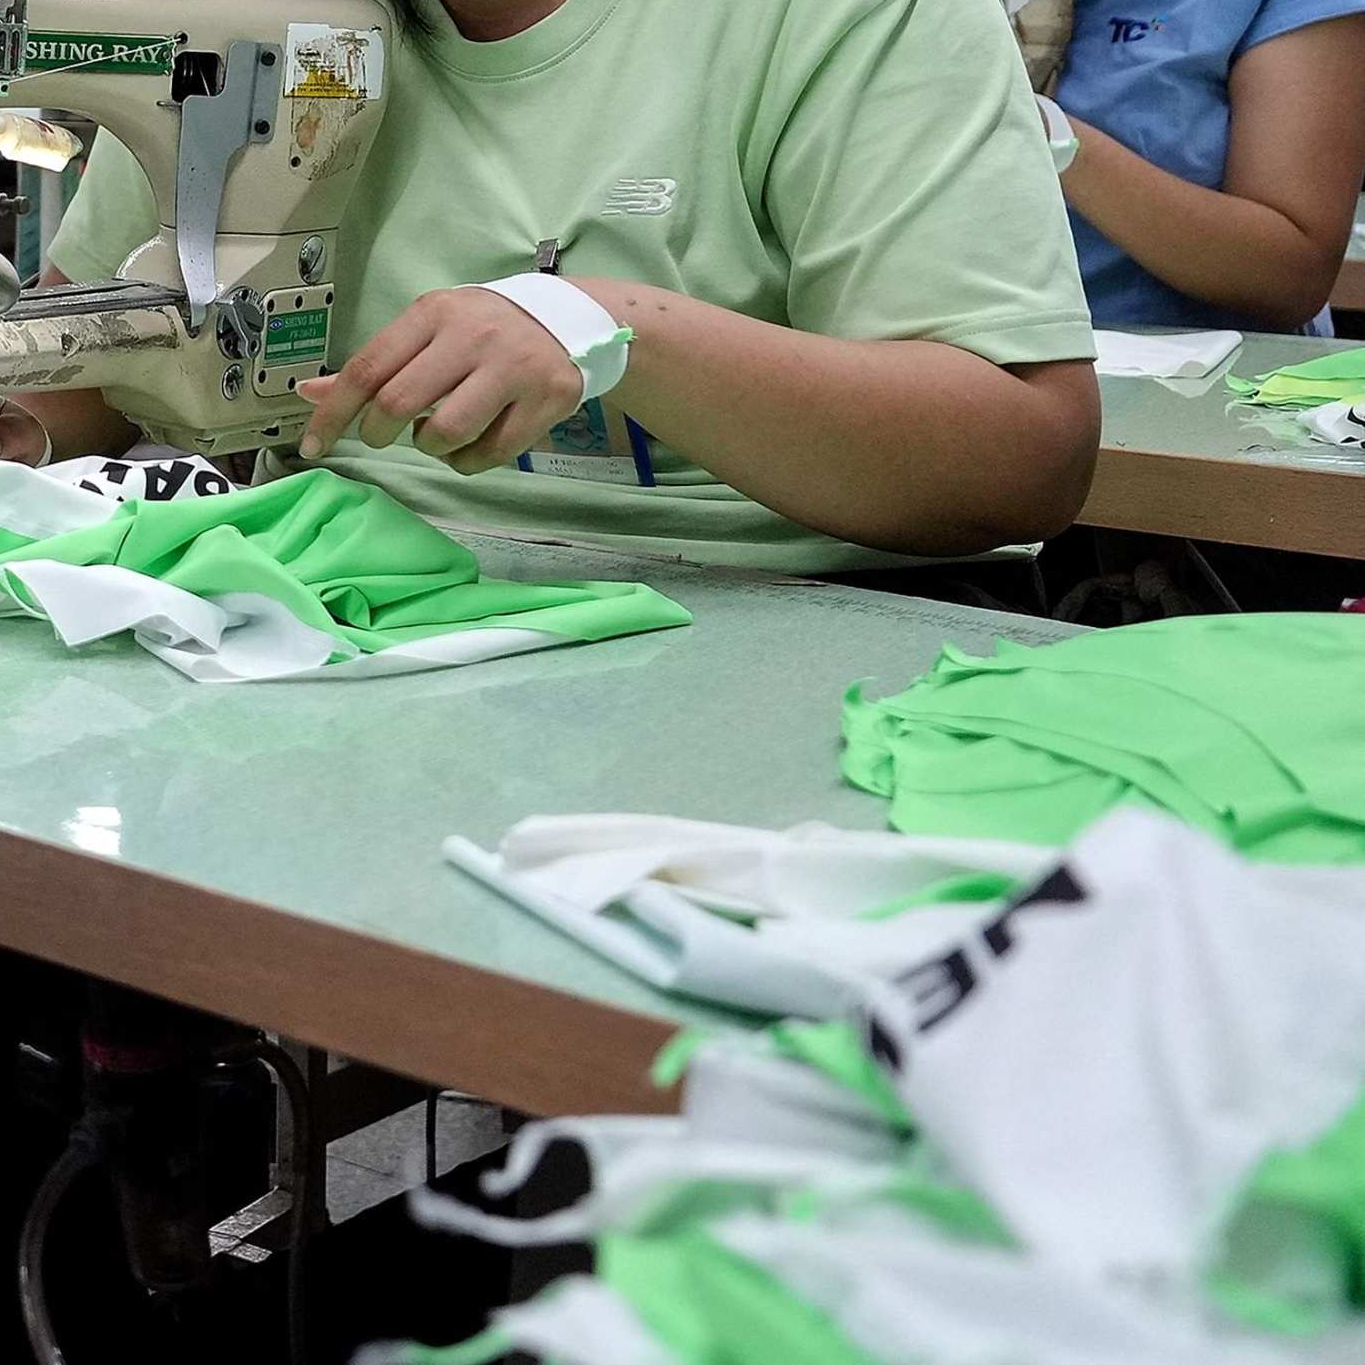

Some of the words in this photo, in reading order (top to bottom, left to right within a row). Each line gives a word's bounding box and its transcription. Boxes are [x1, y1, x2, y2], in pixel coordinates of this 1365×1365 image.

[1108, 16, 1149, 44] TC
[26, 40, 105, 62] SHING
[110, 43, 163, 64] RAY
